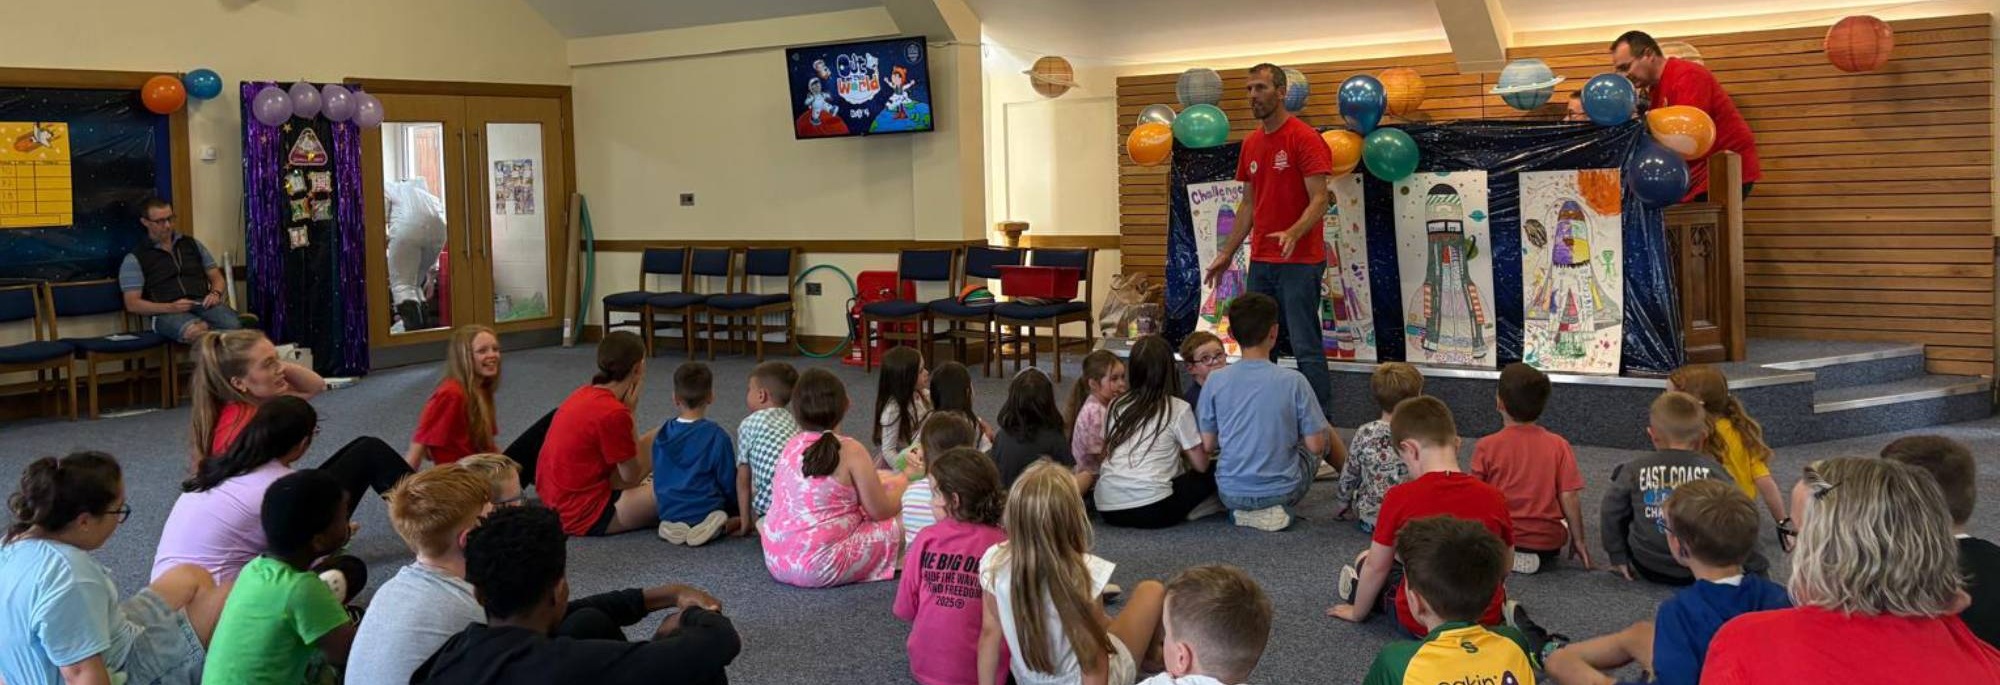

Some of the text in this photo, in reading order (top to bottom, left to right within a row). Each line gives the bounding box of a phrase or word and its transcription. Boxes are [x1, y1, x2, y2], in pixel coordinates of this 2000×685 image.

[1191, 185, 1244, 205] Challenge
[1639, 465, 1710, 491] EAST COAST
[936, 553, 963, 571] BIG
